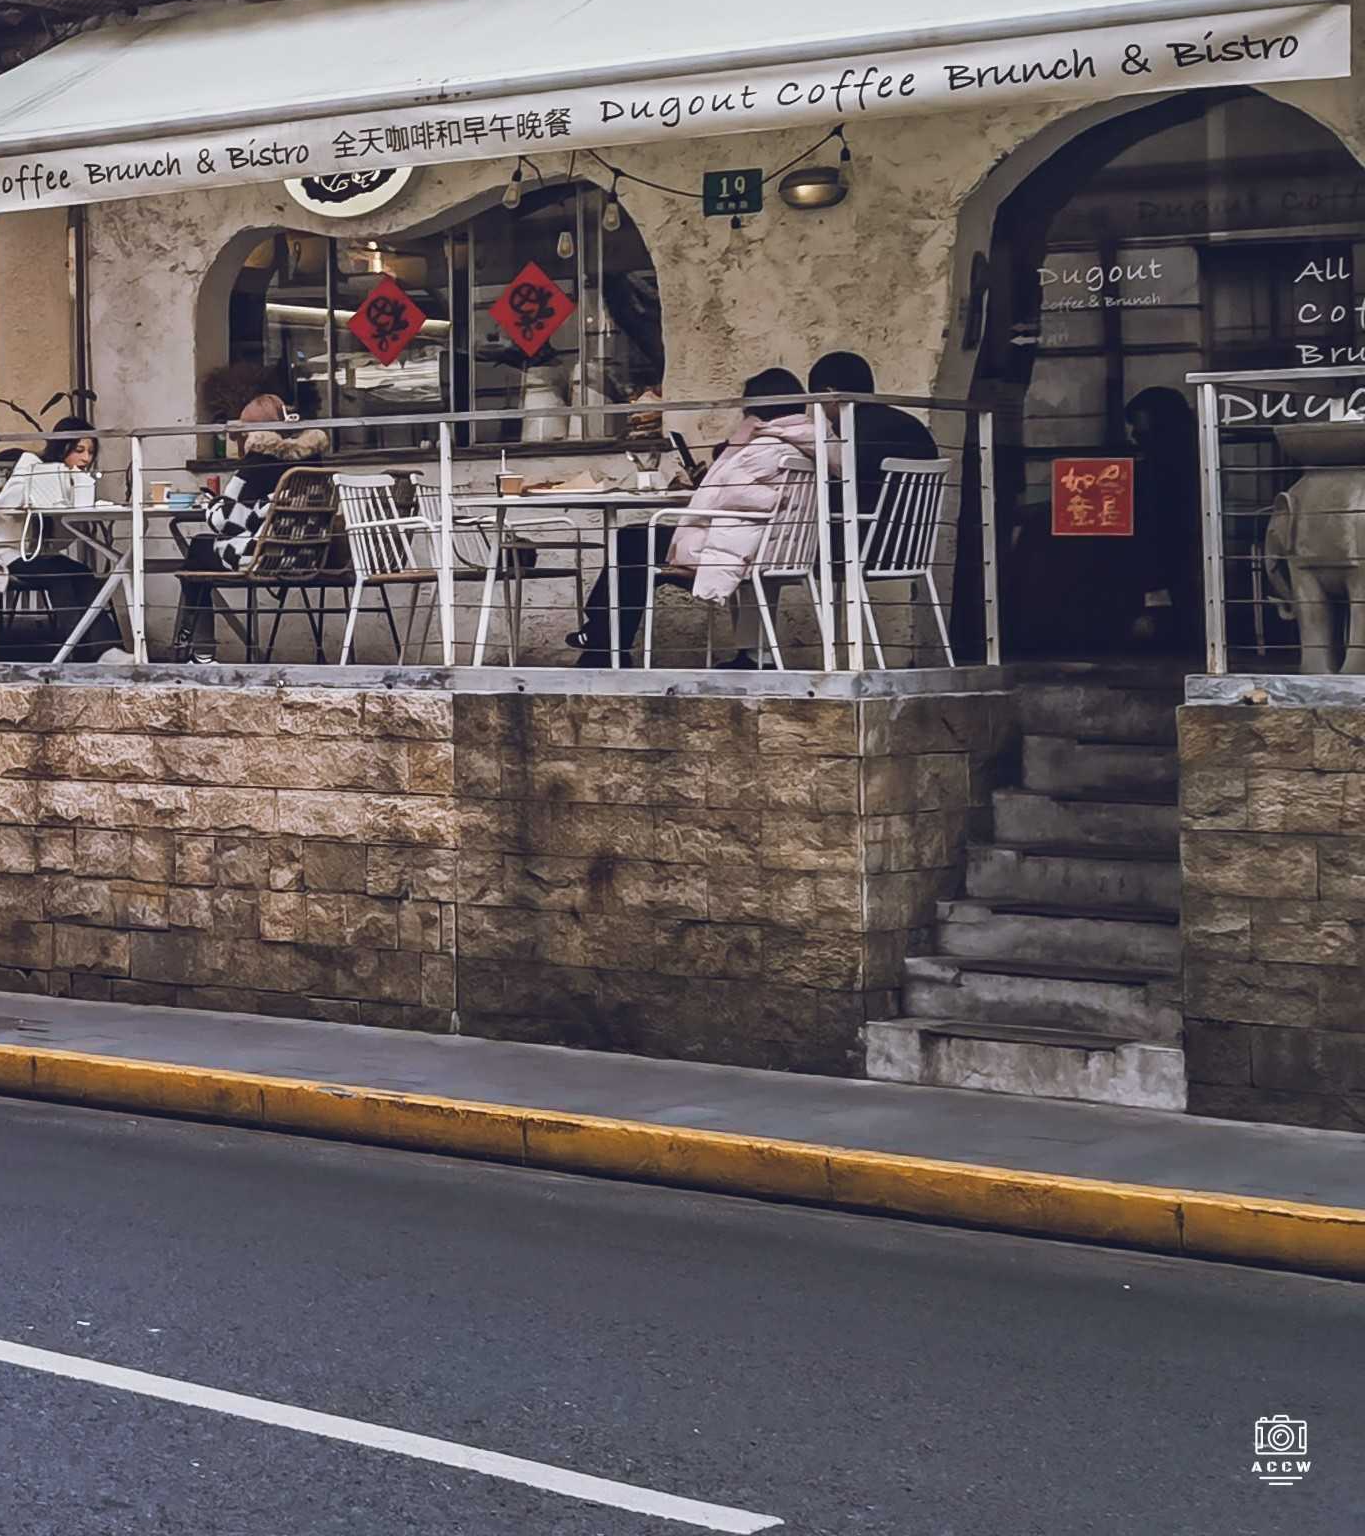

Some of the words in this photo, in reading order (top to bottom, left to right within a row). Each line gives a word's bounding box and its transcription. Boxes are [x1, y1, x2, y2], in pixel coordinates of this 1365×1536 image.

[83, 151, 183, 185] Brunch
[196, 149, 216, 175] &
[225, 138, 310, 170] Bistro
[331, 107, 572, 161] 全天咖啡和早午晚餐
[599, 85, 758, 129] Dugout
[776, 66, 917, 113] Coffee
[943, 48, 1097, 91] Brunch
[1120, 43, 1153, 76] &
[1165, 30, 1300, 68] Bistro
[718, 175, 747, 199] 19
[1036, 258, 1163, 292] Dugout
[1293, 257, 1350, 283] All
[1103, 292, 1162, 308] Brunch
